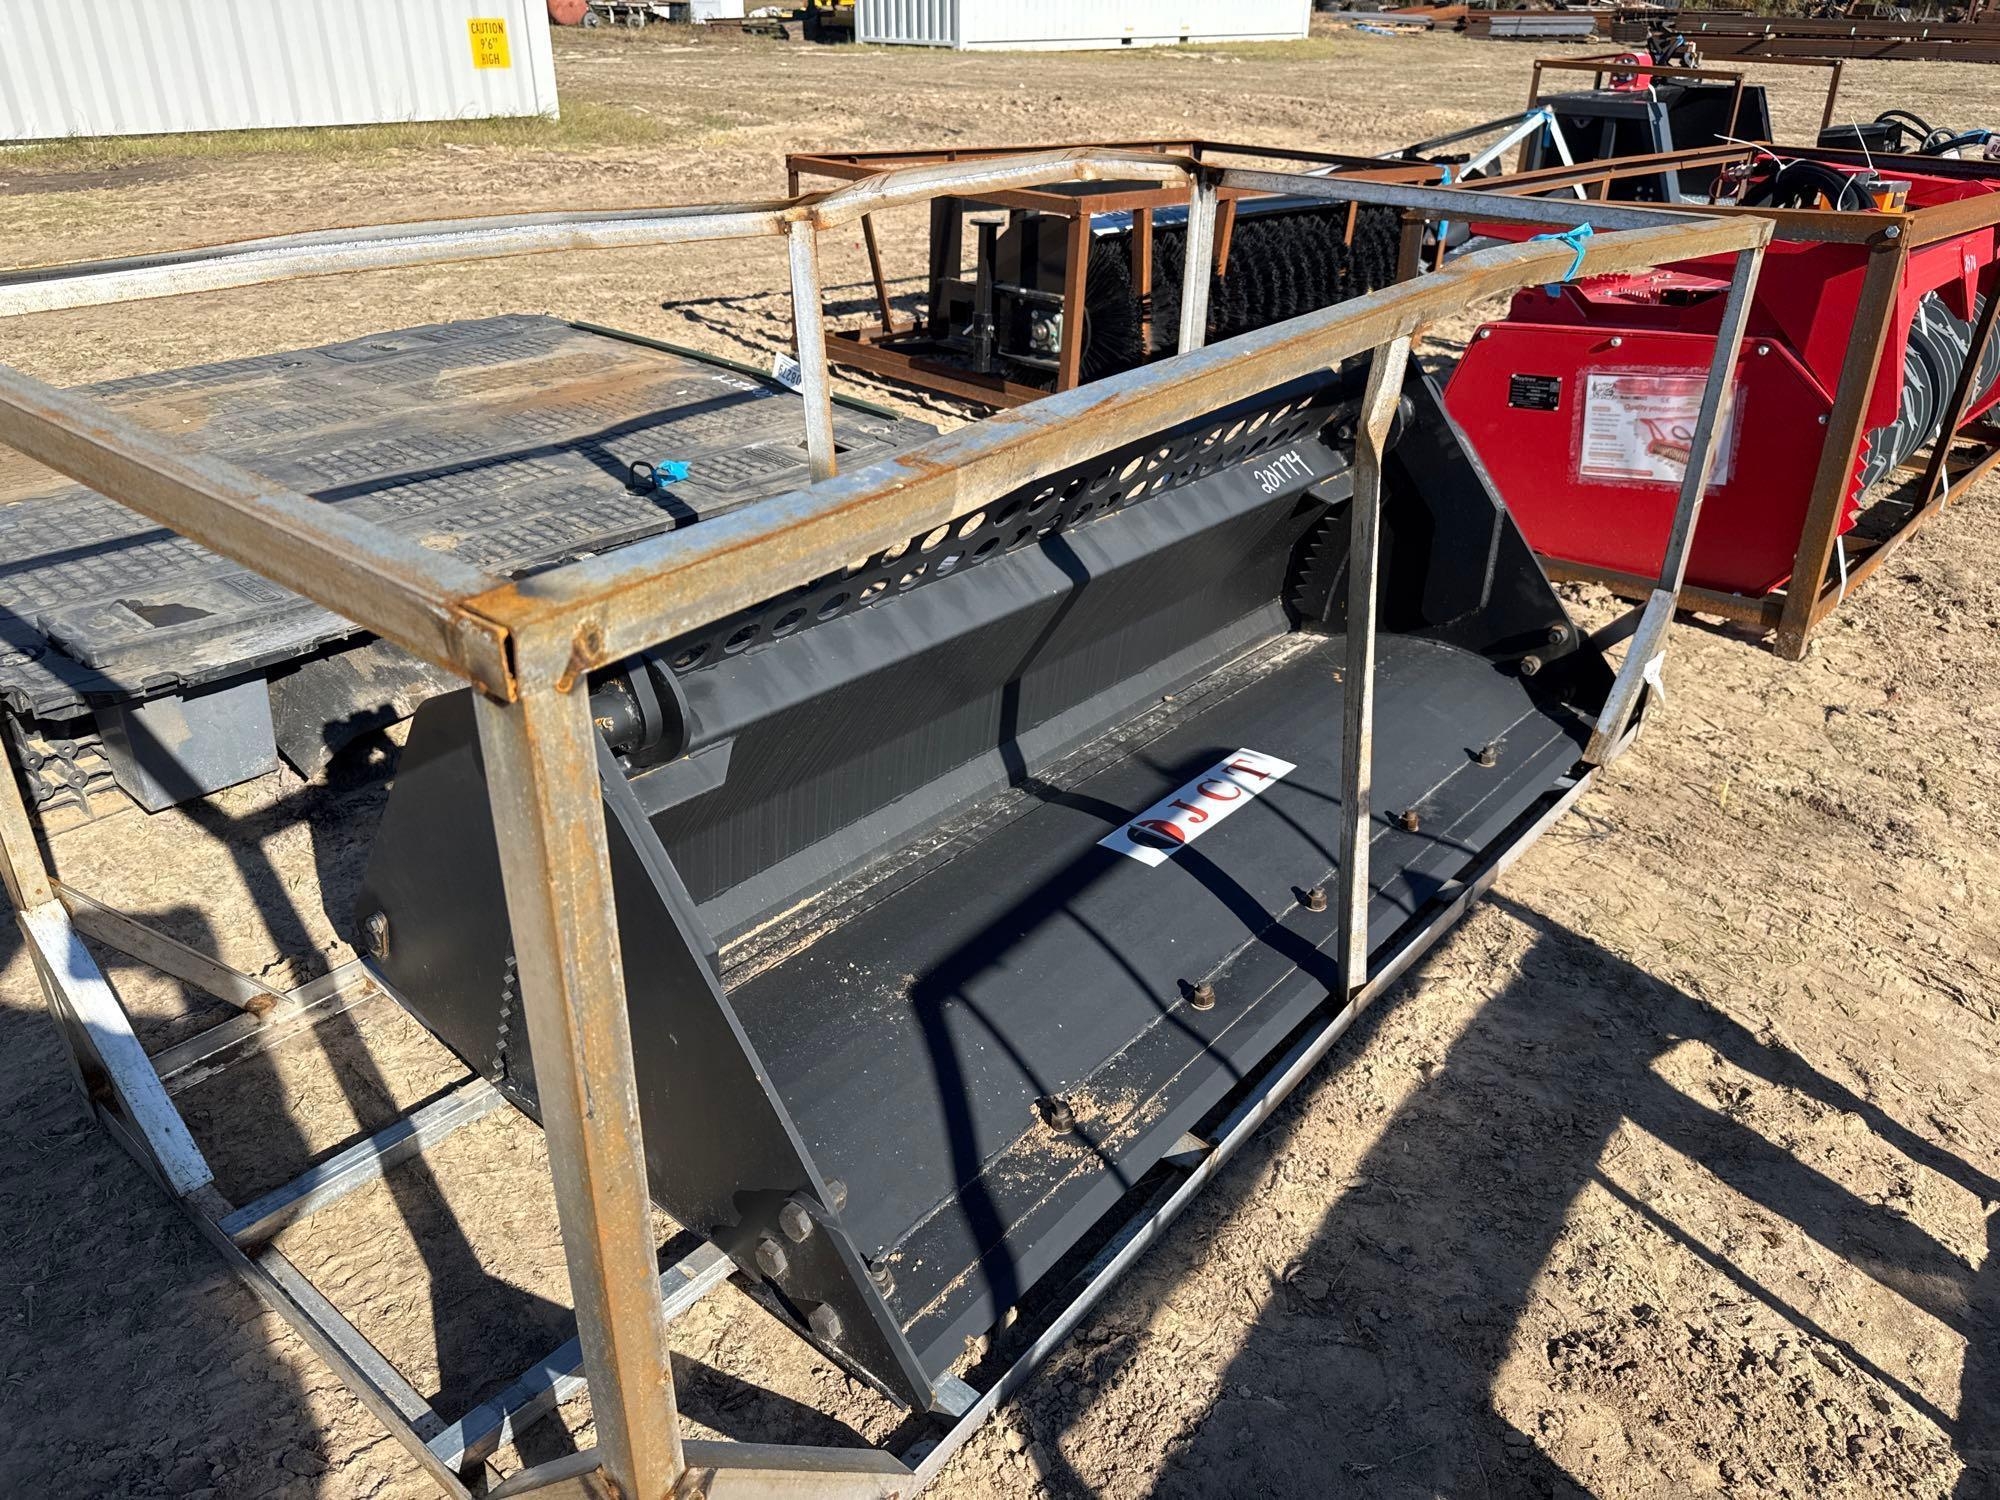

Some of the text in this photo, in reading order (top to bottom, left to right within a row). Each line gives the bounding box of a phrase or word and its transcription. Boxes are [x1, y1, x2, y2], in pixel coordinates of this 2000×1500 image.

[470, 22, 504, 34] CAUTION
[481, 53, 500, 65] HIGH
[1253, 450, 1315, 494] 201774
[1167, 757, 1272, 824] JCT
